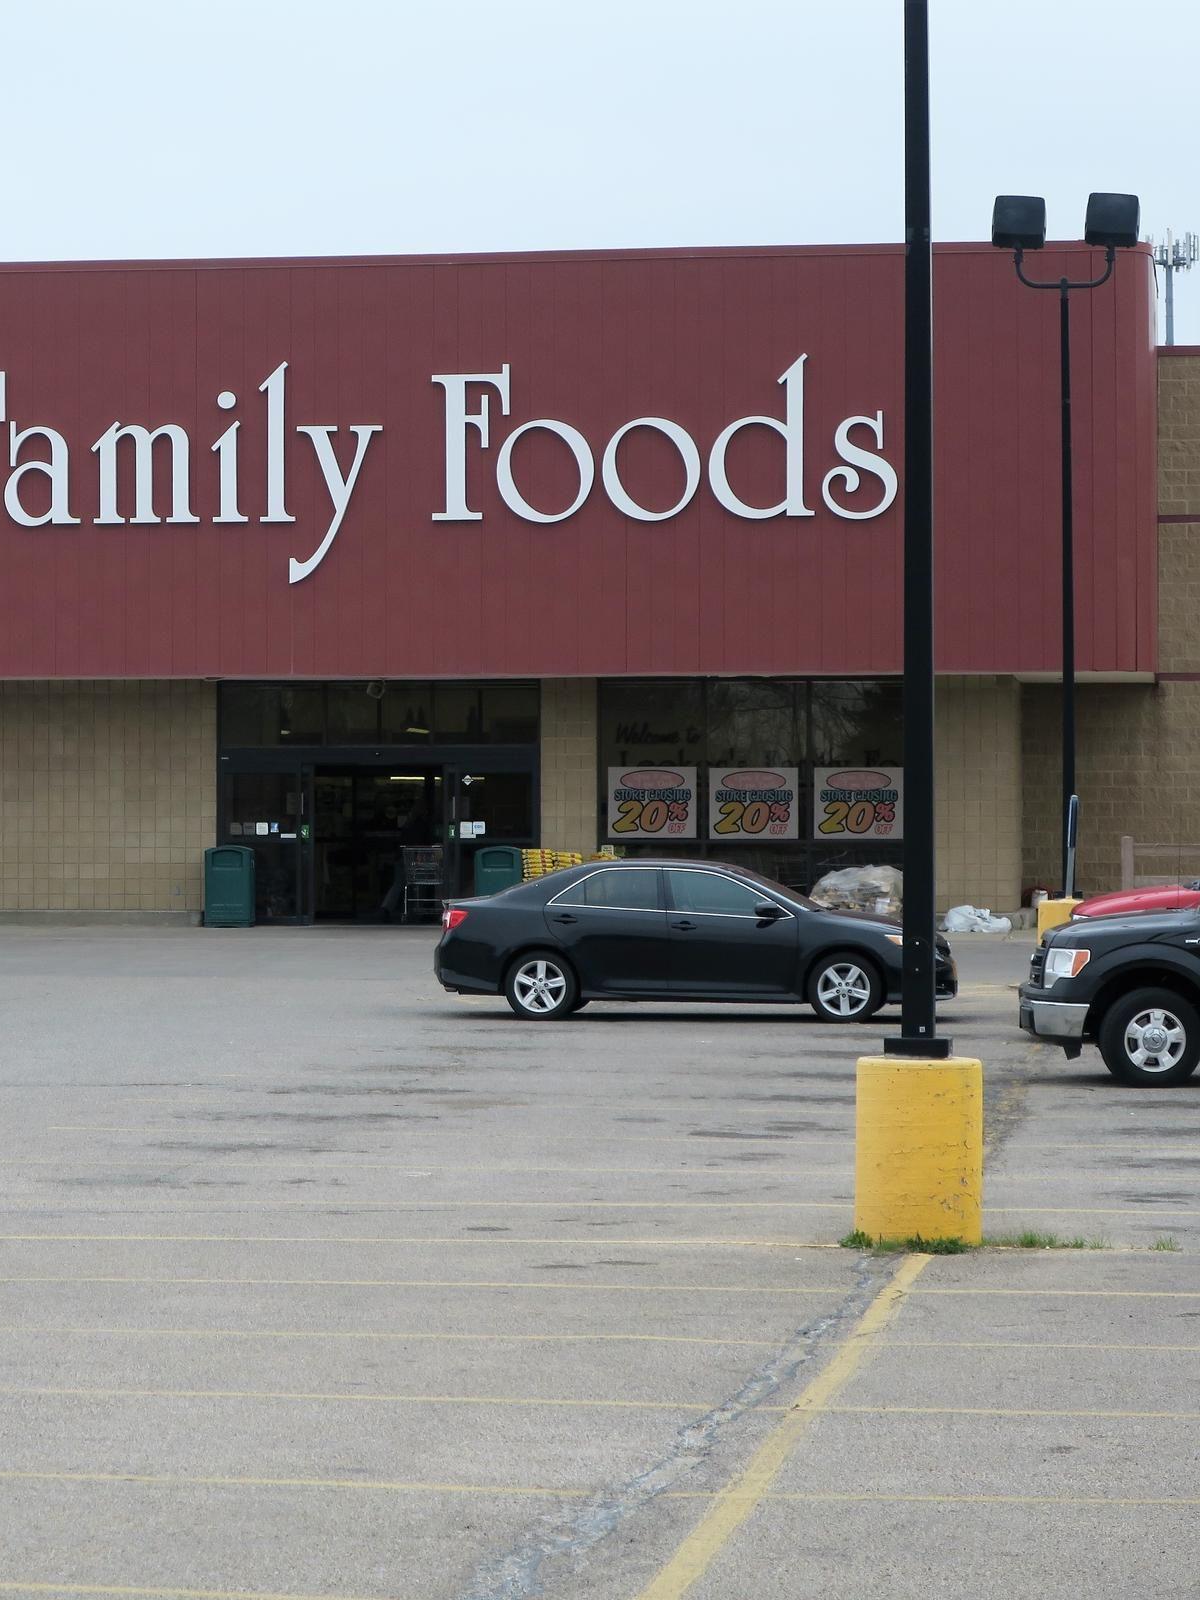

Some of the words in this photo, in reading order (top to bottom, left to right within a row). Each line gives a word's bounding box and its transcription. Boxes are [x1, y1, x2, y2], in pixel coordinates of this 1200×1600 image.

[431, 353, 898, 521] Foods
[614, 789, 646, 802] STORE
[647, 789, 691, 802] CLOSING
[715, 790, 747, 803] STORE
[748, 790, 793, 803] CLOSING
[820, 790, 852, 803] STORE
[853, 790, 898, 803] CLOSING
[667, 823, 686, 834] OFF
[769, 824, 788, 835] OFF
[874, 824, 893, 835] OFF
